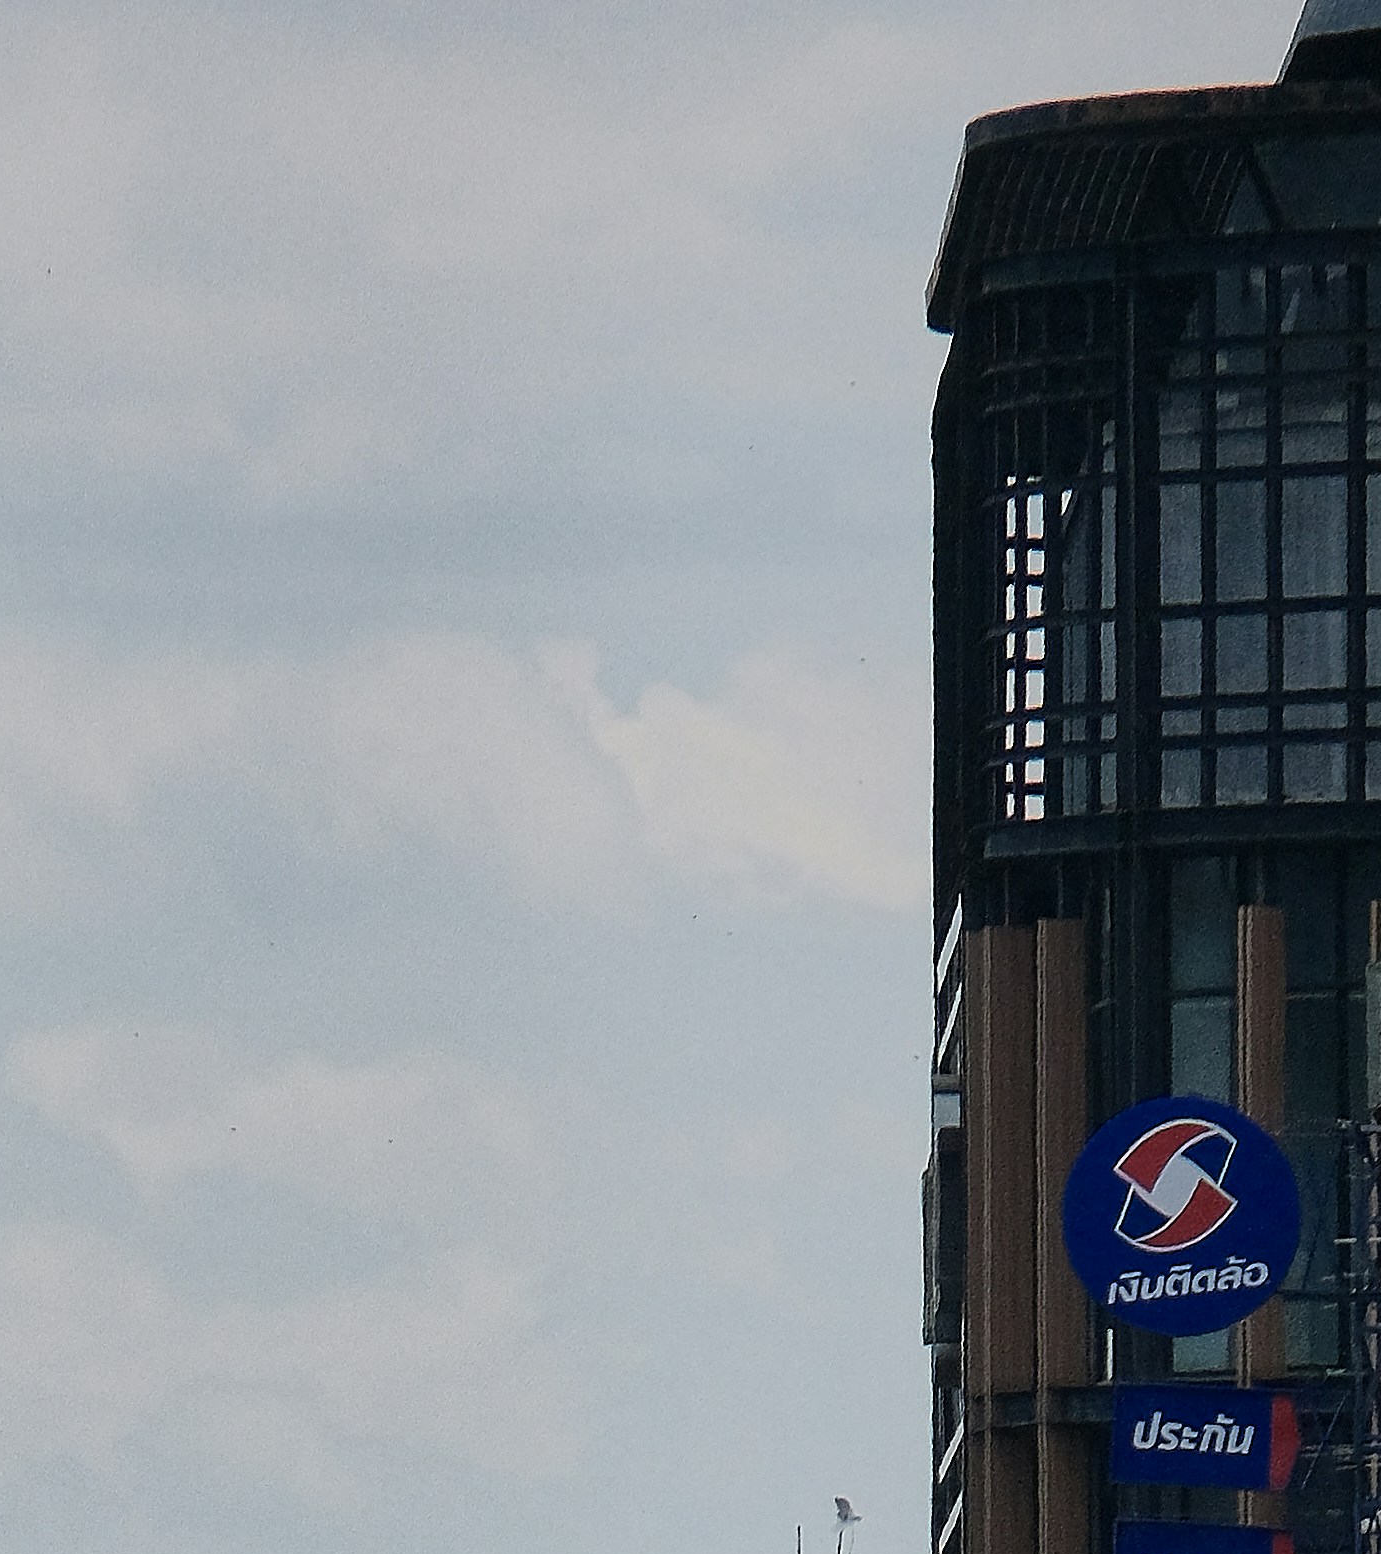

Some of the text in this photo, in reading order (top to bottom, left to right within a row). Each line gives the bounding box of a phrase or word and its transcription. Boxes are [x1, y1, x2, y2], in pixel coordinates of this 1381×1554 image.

[1107, 1256, 1269, 1306] เงินติดล้อ
[1132, 1411, 1255, 1455] ประกัน
